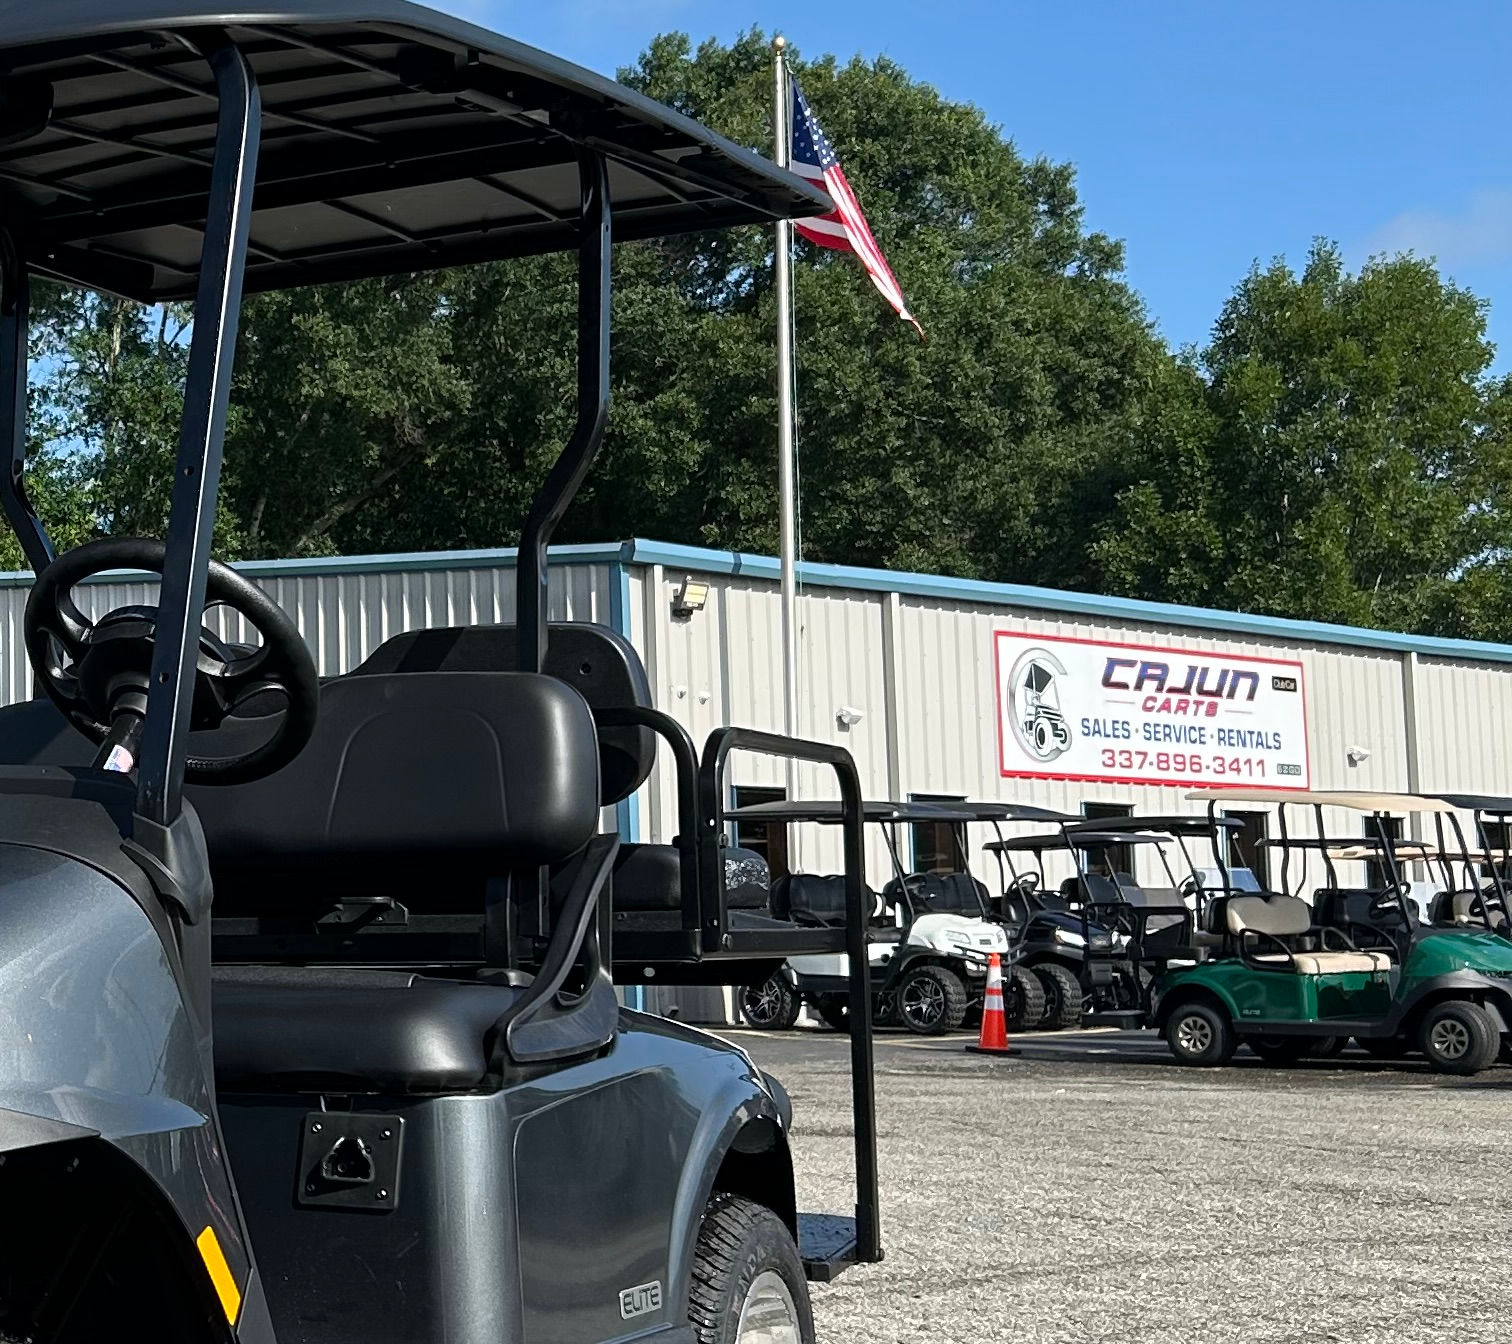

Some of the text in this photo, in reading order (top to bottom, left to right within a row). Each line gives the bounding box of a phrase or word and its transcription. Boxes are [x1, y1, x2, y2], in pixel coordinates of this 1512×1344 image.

[1101, 657, 1260, 702] CAJUN
[1141, 696, 1219, 718] CARTS
[1081, 718, 1282, 750] SALES SERVICE RENTALS
